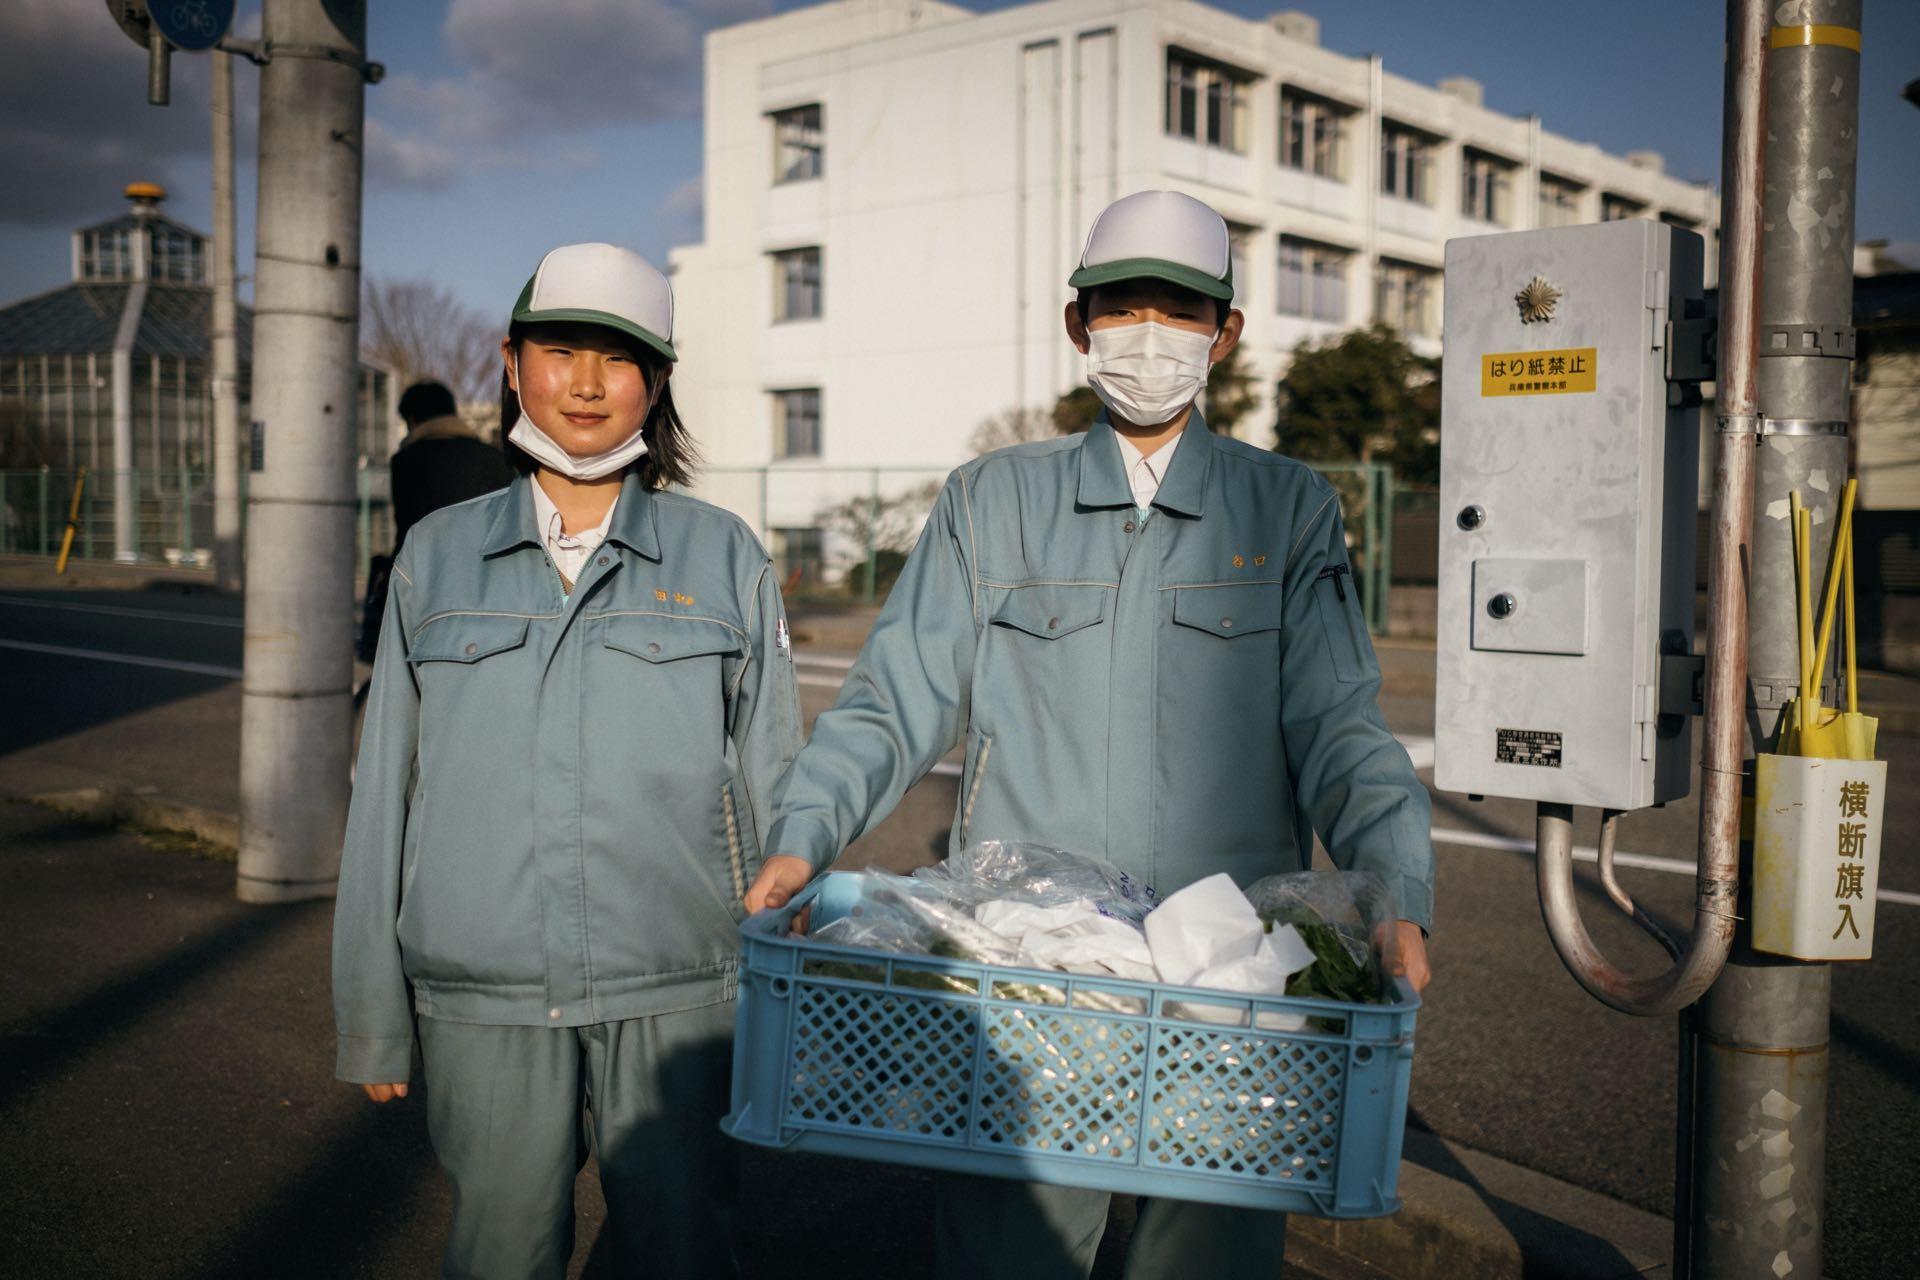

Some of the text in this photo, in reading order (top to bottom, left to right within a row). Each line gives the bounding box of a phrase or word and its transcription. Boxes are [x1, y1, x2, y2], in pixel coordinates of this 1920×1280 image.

[1491, 355, 1586, 378] はり紙禁止
[1833, 780, 1870, 940] 横断旗入
